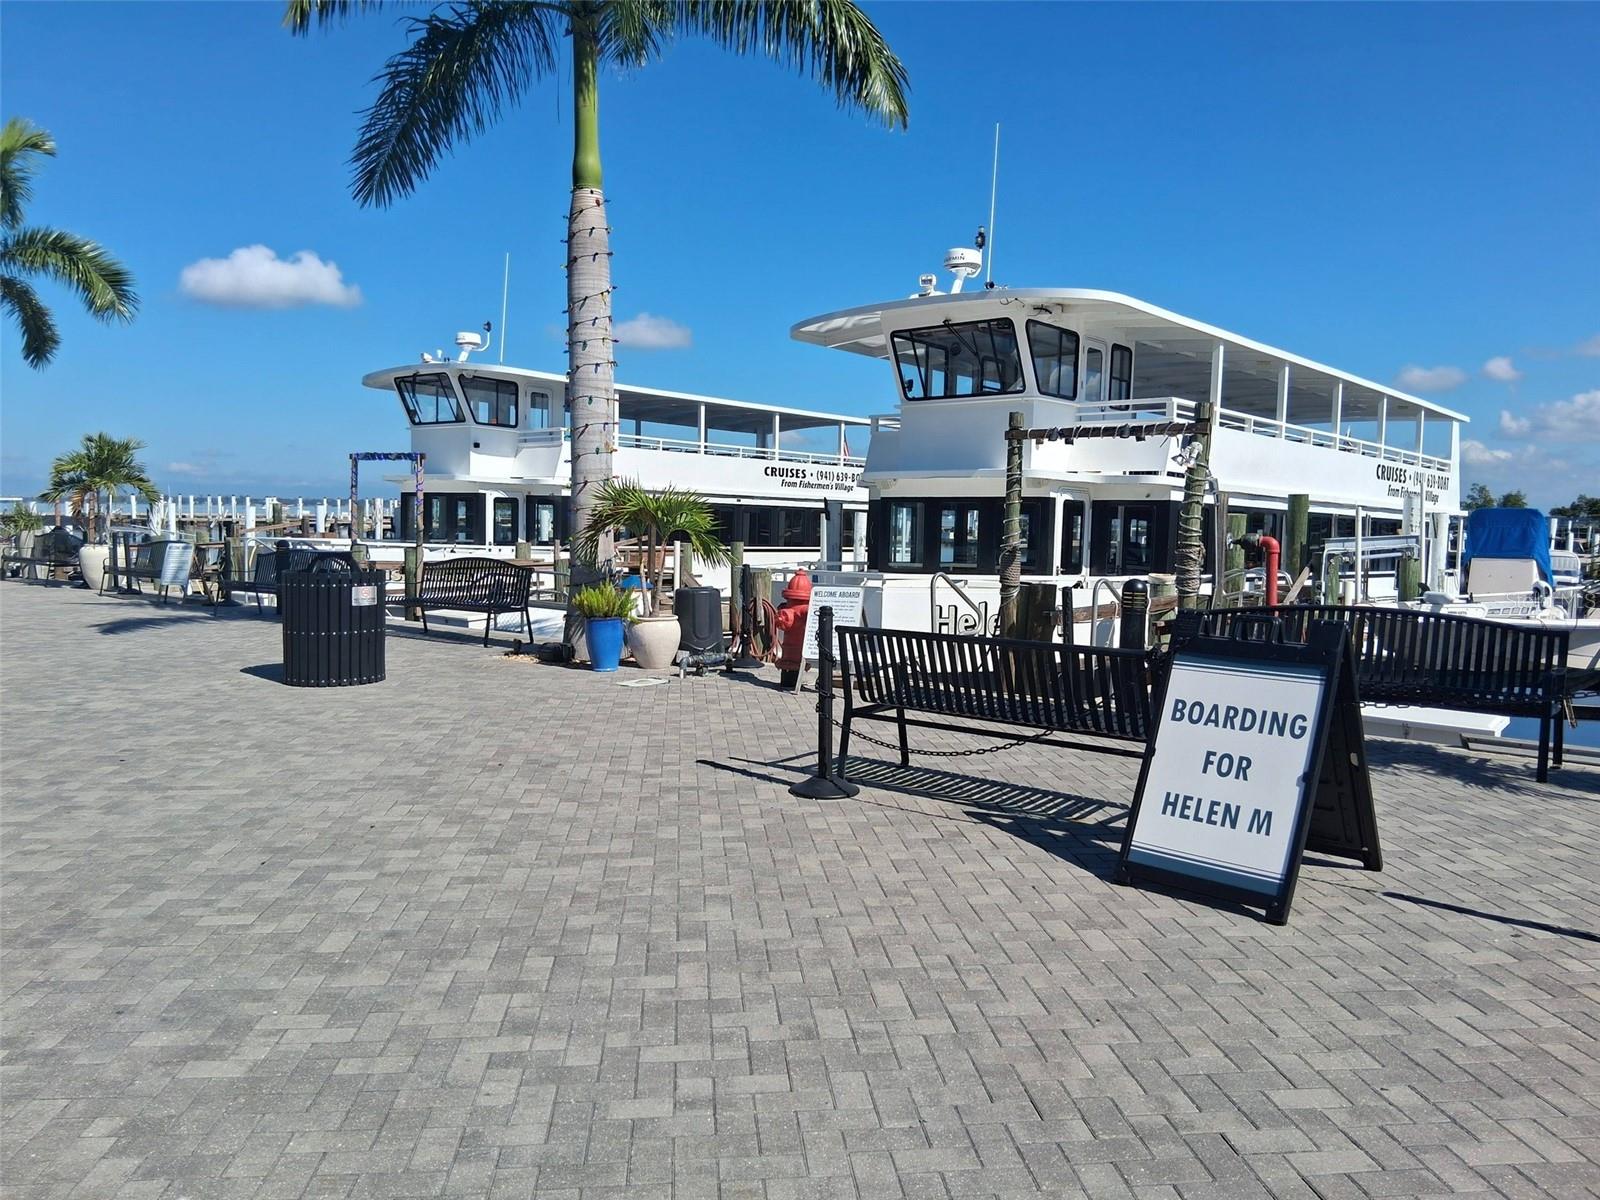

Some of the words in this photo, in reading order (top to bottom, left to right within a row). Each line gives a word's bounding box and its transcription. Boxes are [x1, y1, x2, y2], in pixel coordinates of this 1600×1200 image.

[764, 466, 807, 479] CRUISES
[816, 470, 835, 481] (941)
[836, 472, 863, 482] 639-BO
[1376, 464, 1406, 484] CRUISES
[781, 479, 798, 487] From
[799, 480, 834, 490] Fishermen's
[835, 482, 854, 492] Village
[1387, 484, 1400, 497] From
[814, 590, 838, 598] WELCOME
[935, 601, 1001, 637] Hele
[1170, 698, 1308, 739] BOARDING
[1201, 750, 1252, 781] FOR
[1161, 792, 1241, 829] HELEN
[1247, 808, 1273, 836] M
